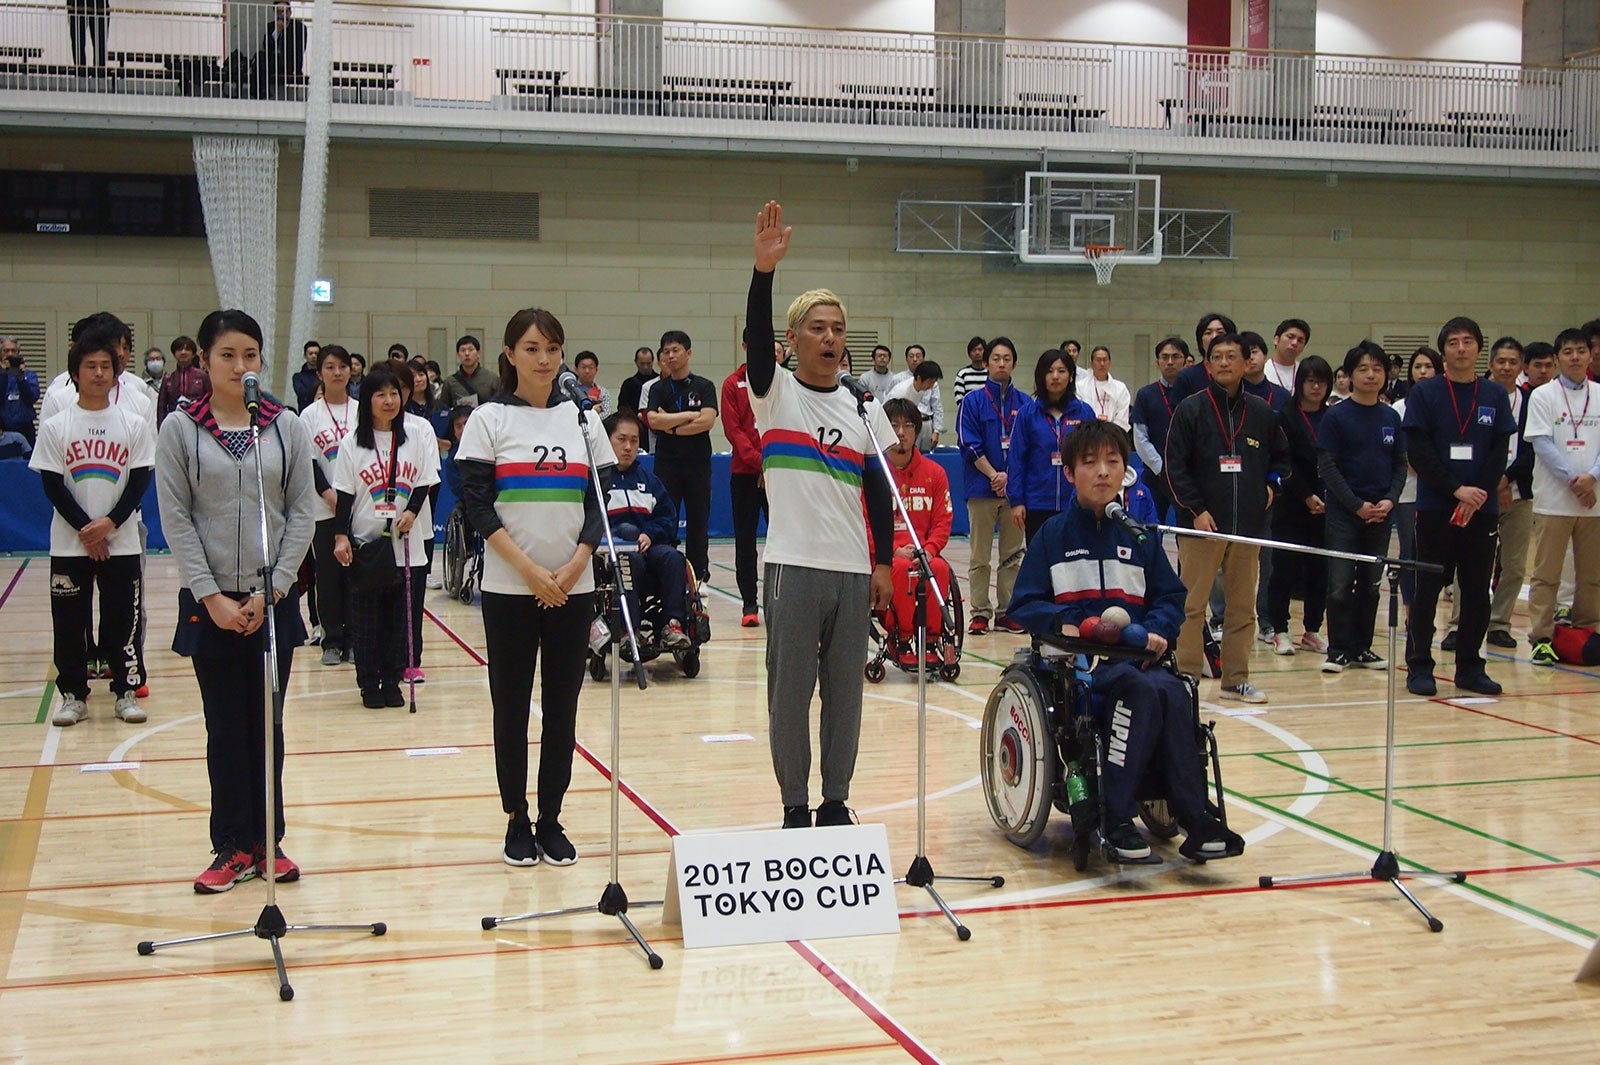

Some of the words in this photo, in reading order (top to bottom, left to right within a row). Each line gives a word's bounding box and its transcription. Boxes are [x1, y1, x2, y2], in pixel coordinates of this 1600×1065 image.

[88, 428, 106, 436] TEAM
[817, 426, 843, 454] 12
[533, 445, 567, 471] 23
[618, 554, 634, 591] JAPAN
[1107, 699, 1133, 767] JAPAN
[684, 861, 751, 887] 2017
[764, 853, 886, 882] BOCCIA
[694, 888, 804, 917] TOKYO
[816, 883, 880, 909] CUP
